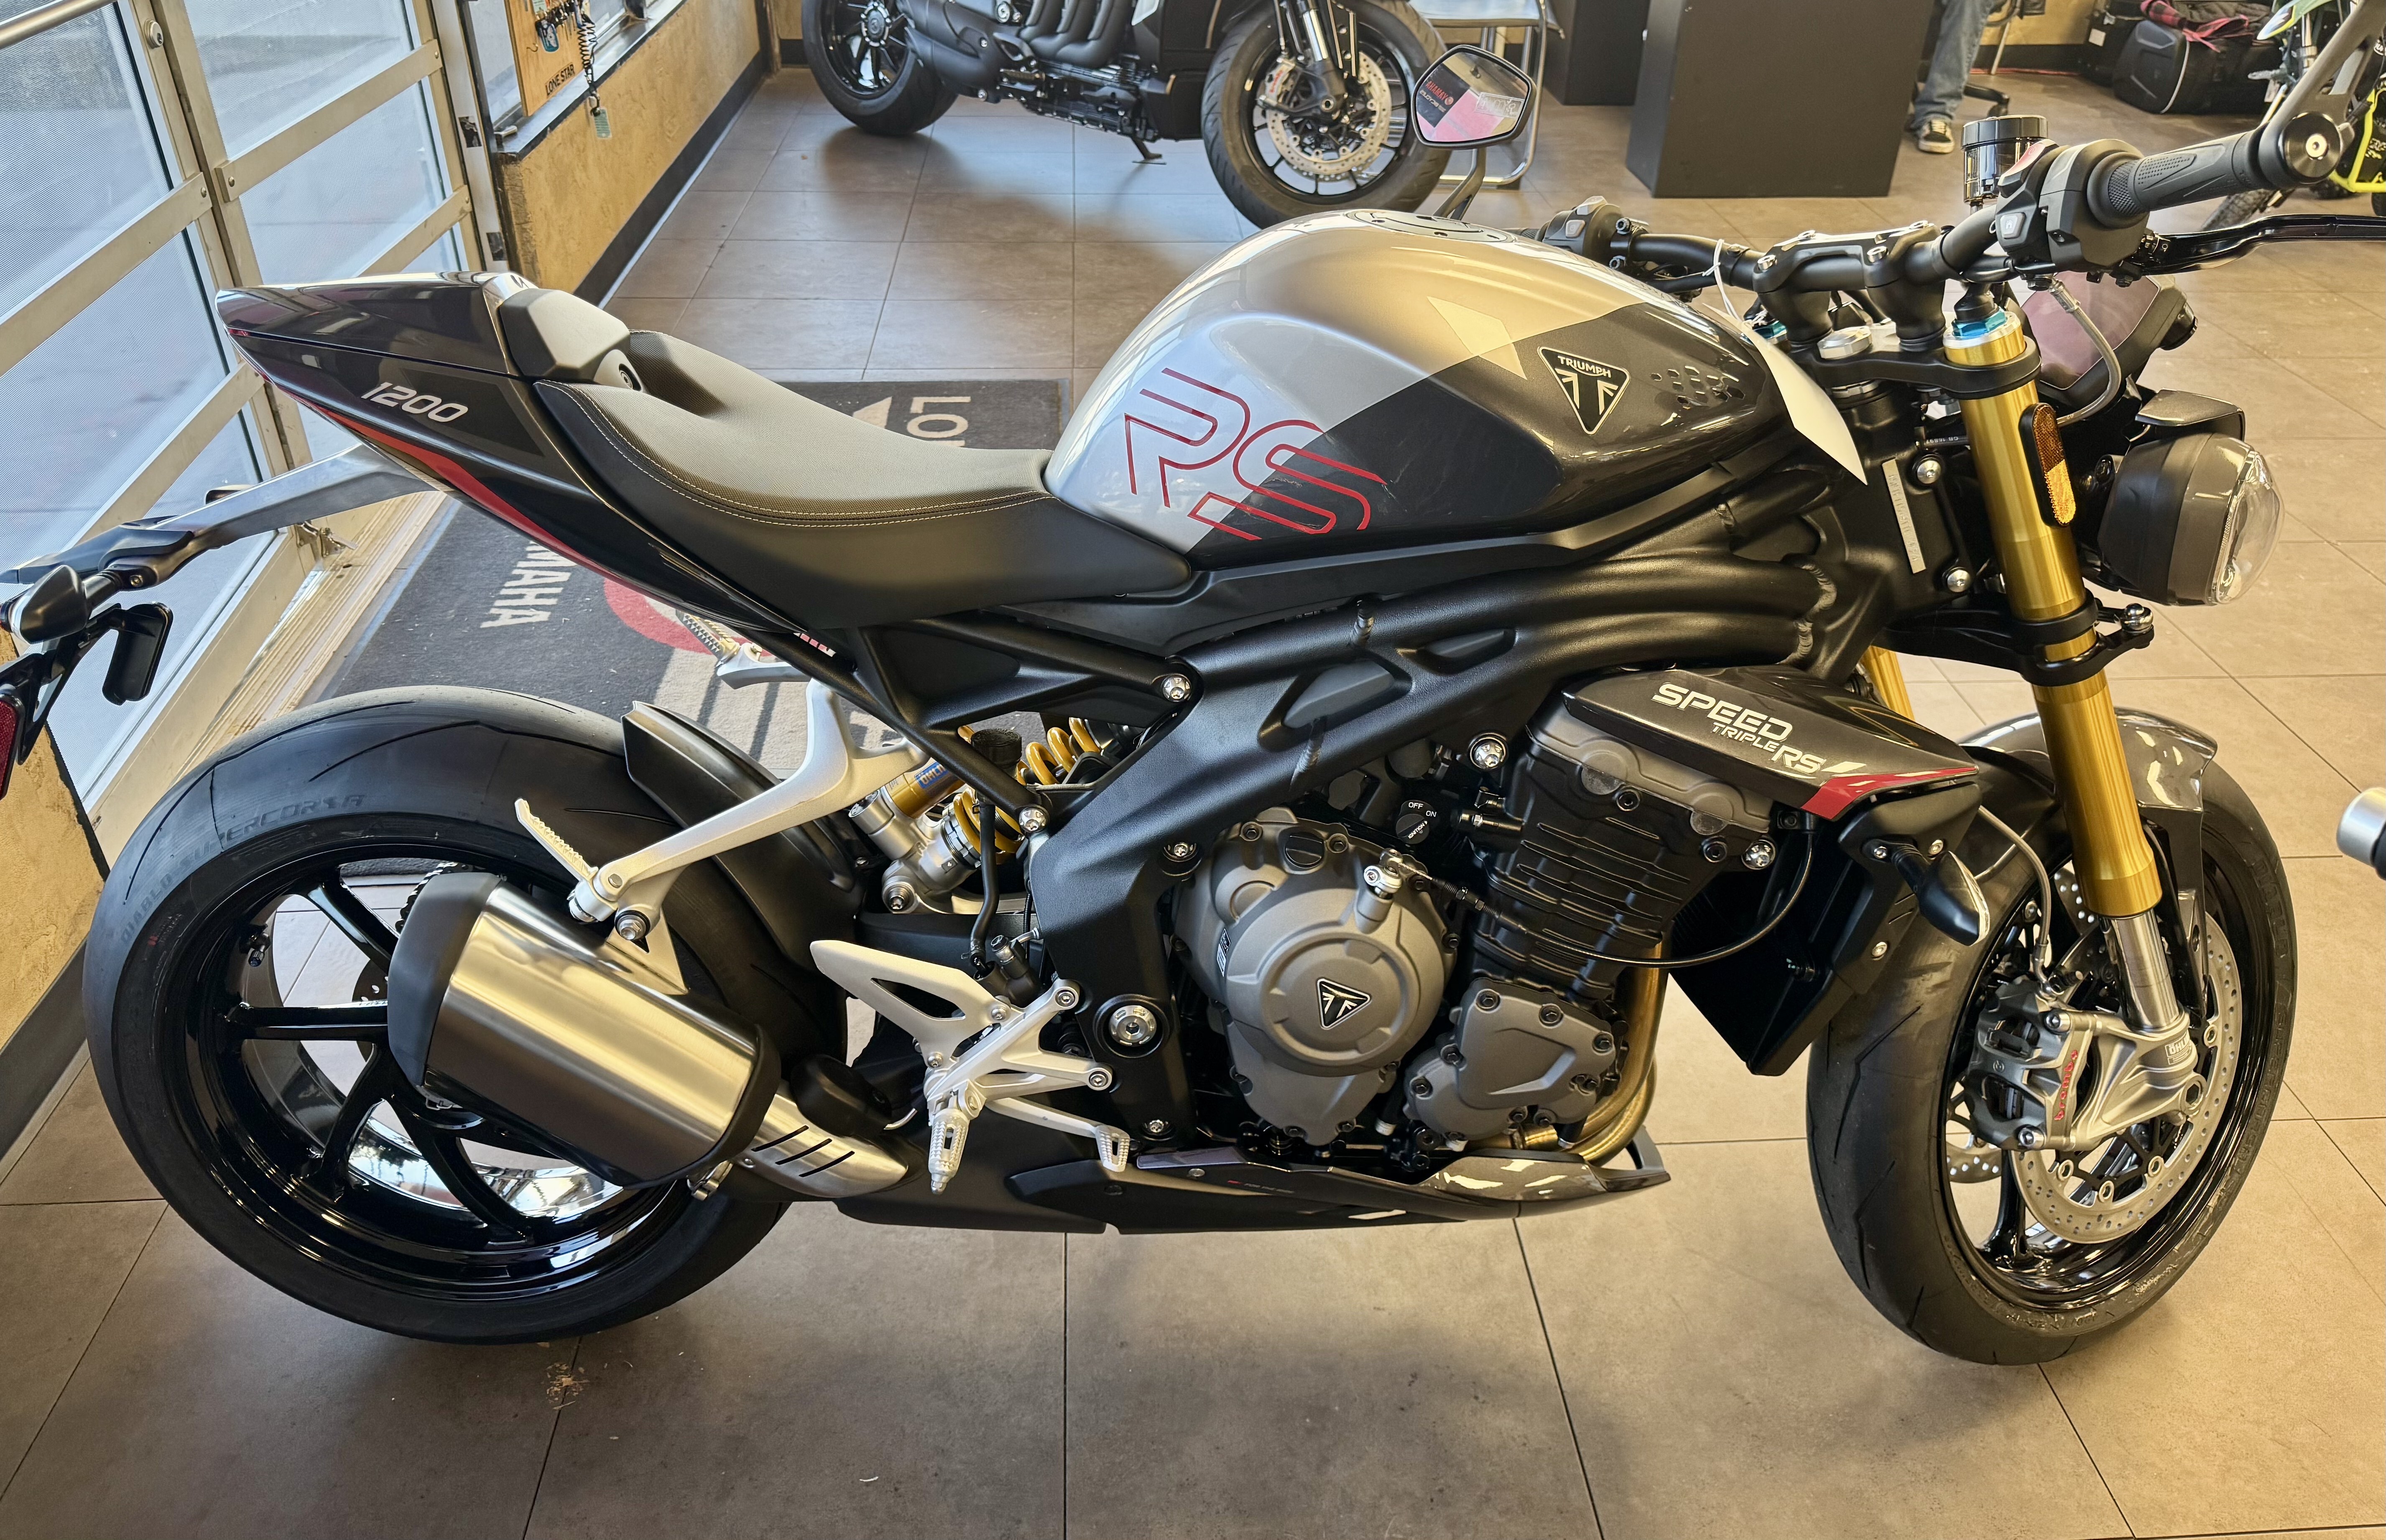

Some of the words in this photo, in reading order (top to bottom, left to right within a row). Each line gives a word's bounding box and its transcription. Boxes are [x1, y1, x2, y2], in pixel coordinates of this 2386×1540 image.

[545, 75, 561, 96] LONE
[560, 64, 575, 82] STAR
[1557, 355, 1611, 378] TRIUMPH
[361, 382, 468, 422] 1200
[906, 396, 971, 448] LO
[1124, 367, 1388, 541] RS
[480, 541, 578, 628] MAHA
[1651, 682, 1793, 742] SPEED
[1713, 722, 1780, 752] TRIPLE
[1771, 745, 1826, 775] RS
[1408, 823, 1425, 839] IGNITION
[120, 873, 173, 943] DIABLO
[2054, 1050, 2078, 1120] brembo
